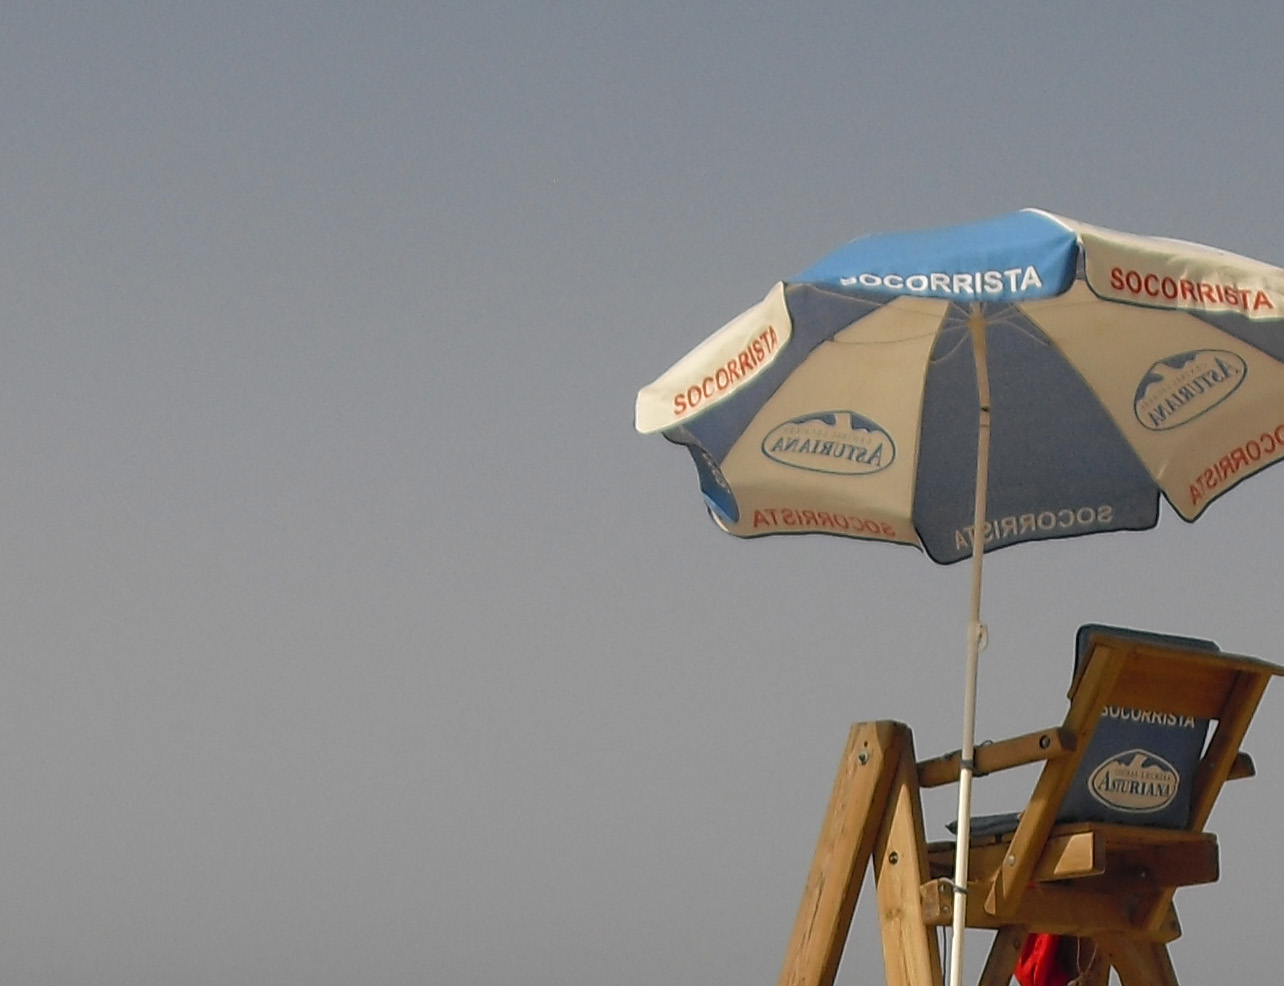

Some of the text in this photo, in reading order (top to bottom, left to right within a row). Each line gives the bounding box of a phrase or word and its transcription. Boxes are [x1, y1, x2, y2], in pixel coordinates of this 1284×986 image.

[1110, 267, 1274, 311] SOCORRISTA
[673, 324, 779, 415] SOCORRISTA
[1099, 770, 1172, 797] ASTURIANA
